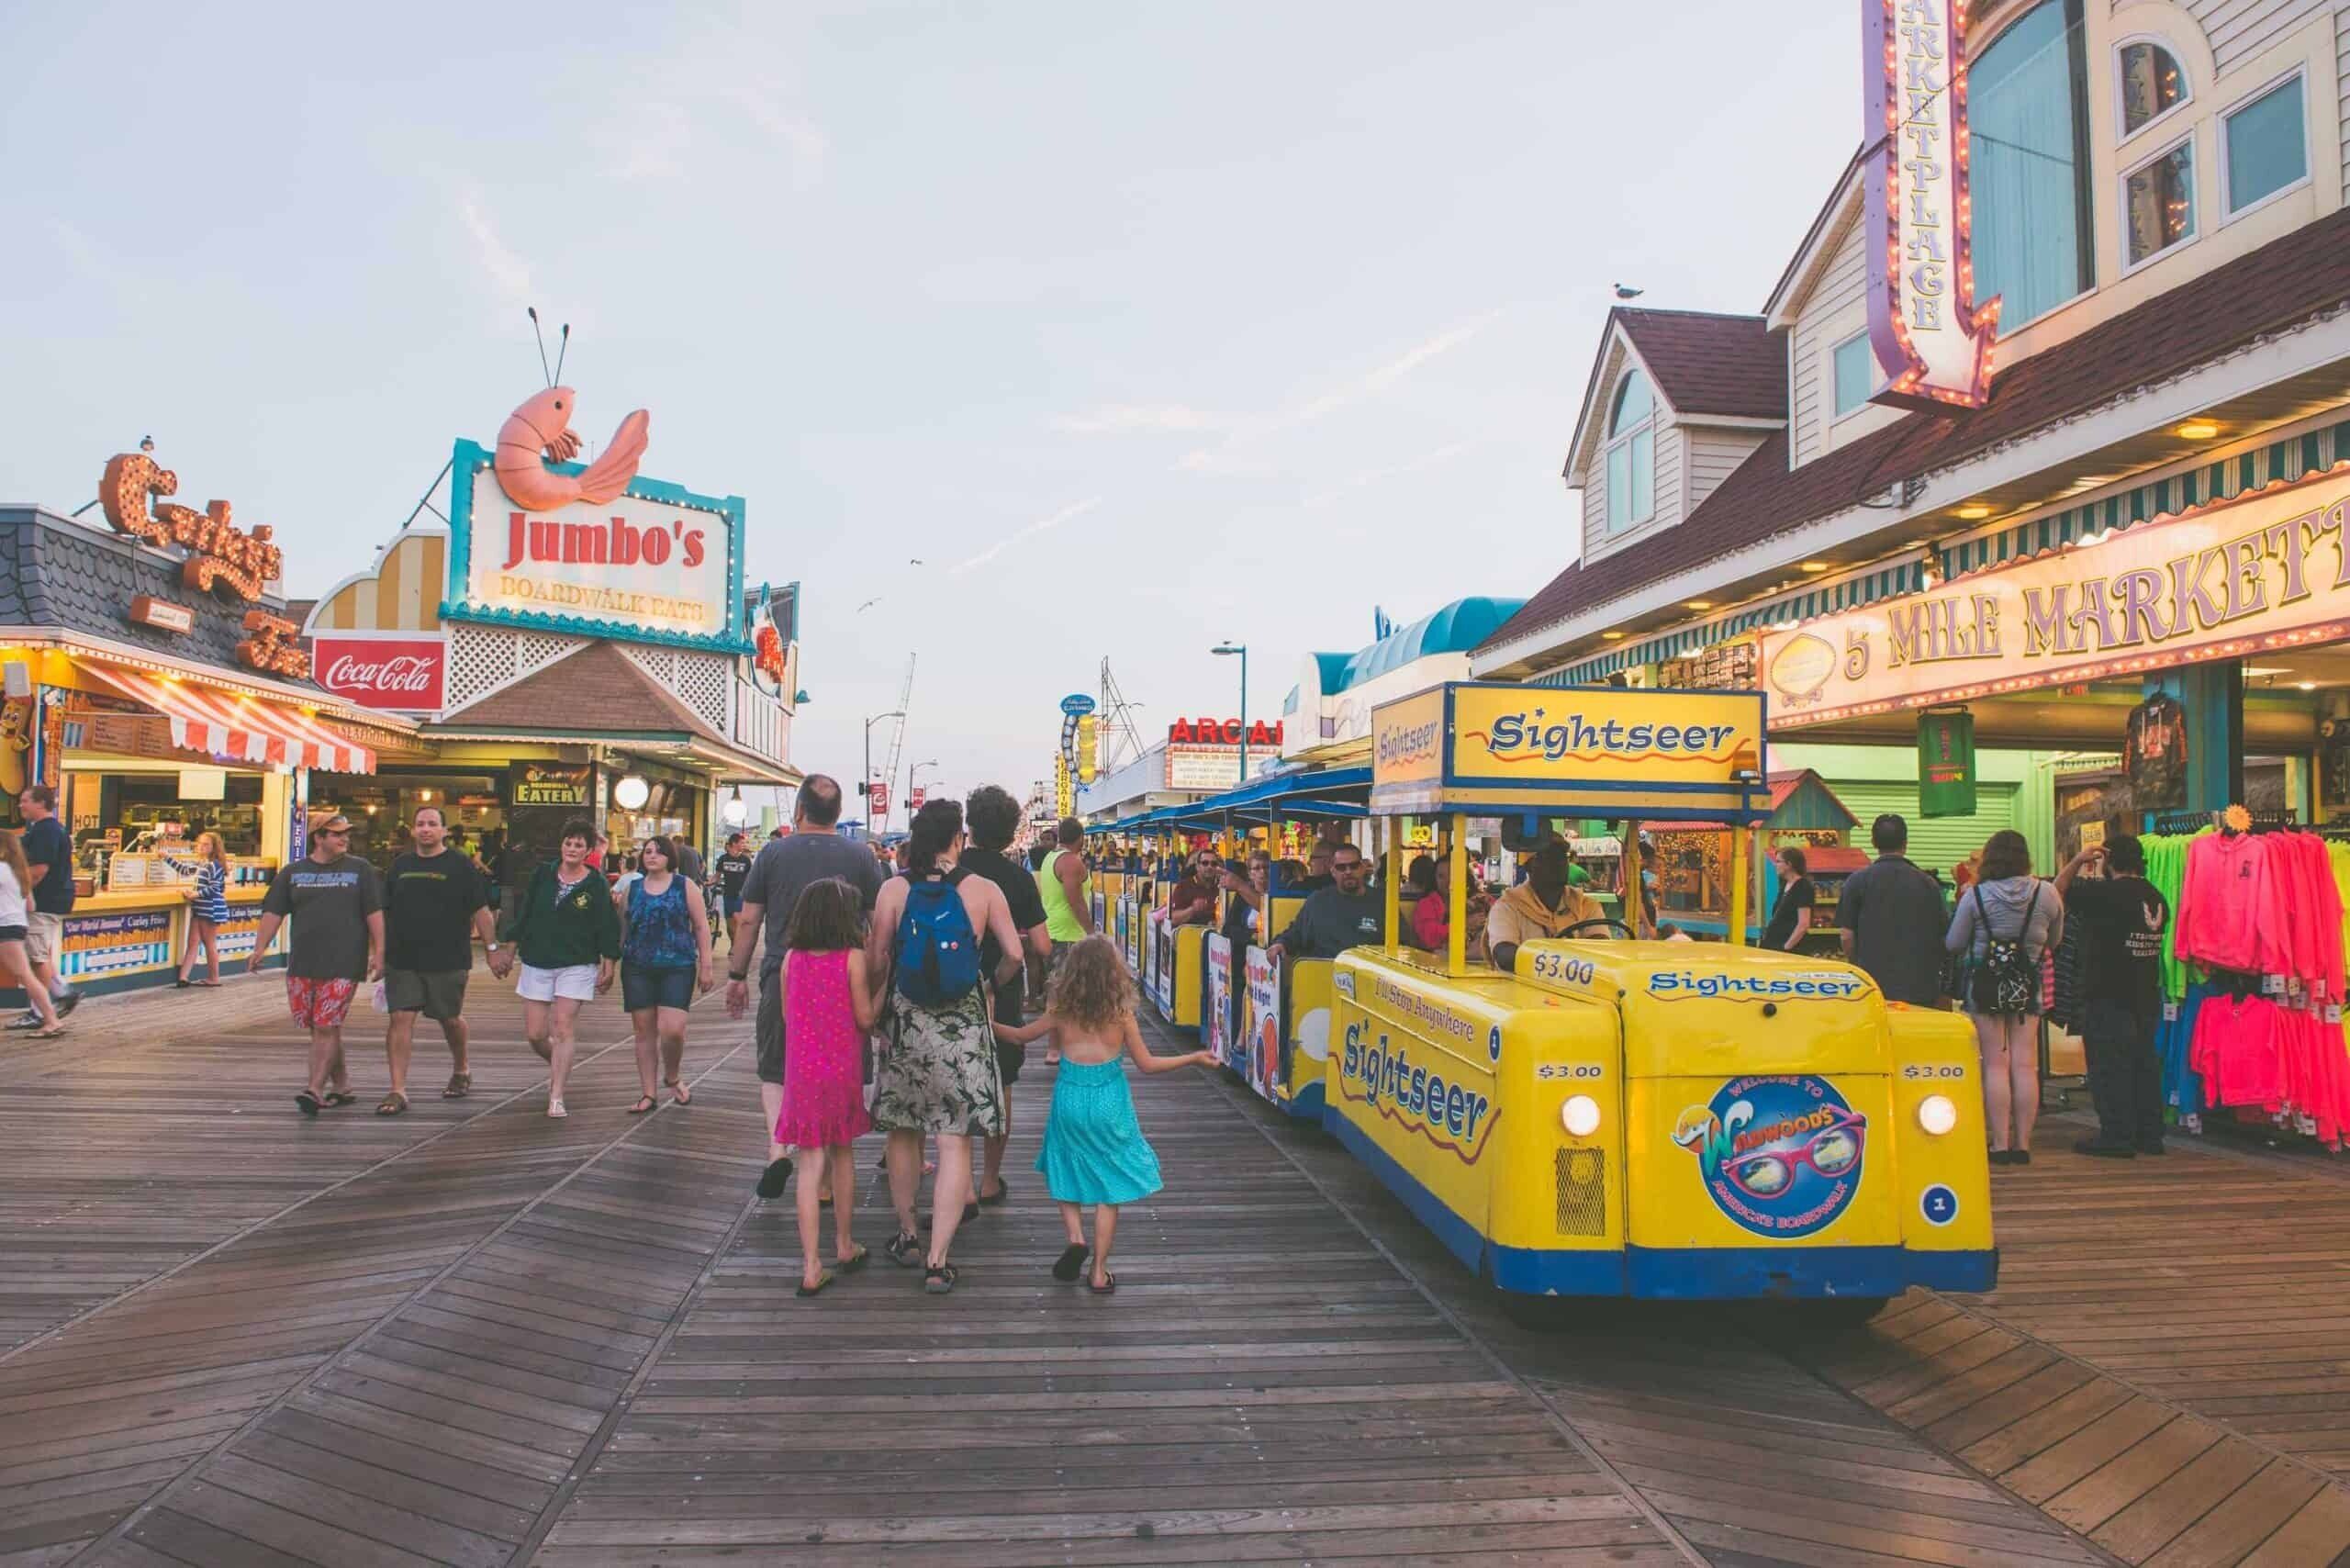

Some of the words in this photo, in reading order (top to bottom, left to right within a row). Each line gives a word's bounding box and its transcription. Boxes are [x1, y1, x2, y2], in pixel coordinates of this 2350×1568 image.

[501, 512, 705, 571] Jumbo's
[499, 576, 648, 615] BOARDWALK
[651, 598, 704, 622] EATS
[1844, 627, 1871, 681] 5
[1887, 595, 2003, 667] MILE
[326, 655, 438, 690] Coca-Cola
[1380, 721, 1438, 759] Sightseer
[1488, 706, 1734, 761] Sightseer
[518, 785, 587, 801] EATERY
[74, 815, 98, 827] HOT
[1535, 953, 1594, 985] $3.00
[1651, 971, 1861, 997] Sightseer
[1389, 984, 1413, 1014] Stop
[1414, 994, 1474, 1042] Anywhere
[1343, 1019, 1487, 1142] Sightseer
[1539, 1065, 1602, 1079] $3.00
[1904, 1065, 1964, 1079] $3.00
[1804, 1080, 1824, 1098] TO
[1932, 1198, 1945, 1211] 1
